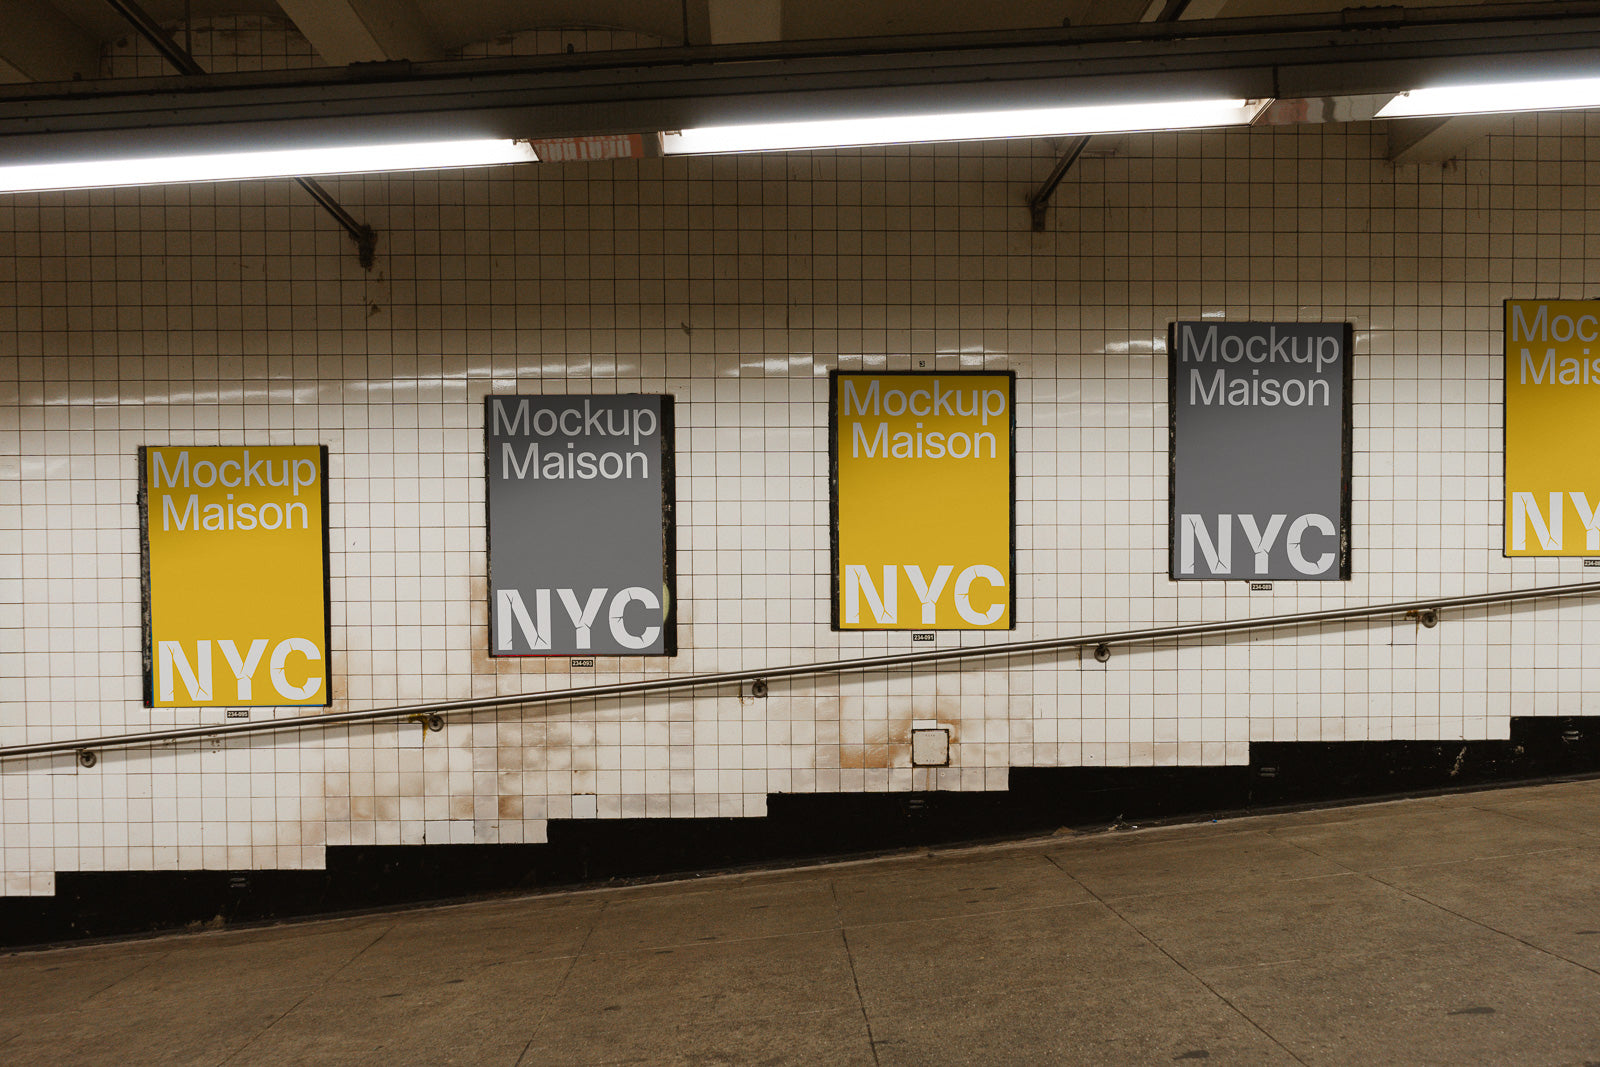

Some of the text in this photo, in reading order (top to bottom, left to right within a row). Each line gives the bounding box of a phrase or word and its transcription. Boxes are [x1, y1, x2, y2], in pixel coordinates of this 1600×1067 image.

[1512, 304, 1599, 342] Moc
[1182, 325, 1340, 373] Mockup
[844, 379, 1006, 426] Mockup
[1189, 368, 1330, 406] Maison
[492, 399, 657, 446] Mockup
[852, 422, 996, 459] Maison
[152, 450, 316, 496] Mockup
[502, 442, 649, 480] Maison
[162, 493, 308, 531] Maison
[1180, 513, 1336, 575] NYC
[496, 586, 661, 651] NYC
[844, 564, 1006, 626] NYC
[158, 637, 323, 702] NYC
